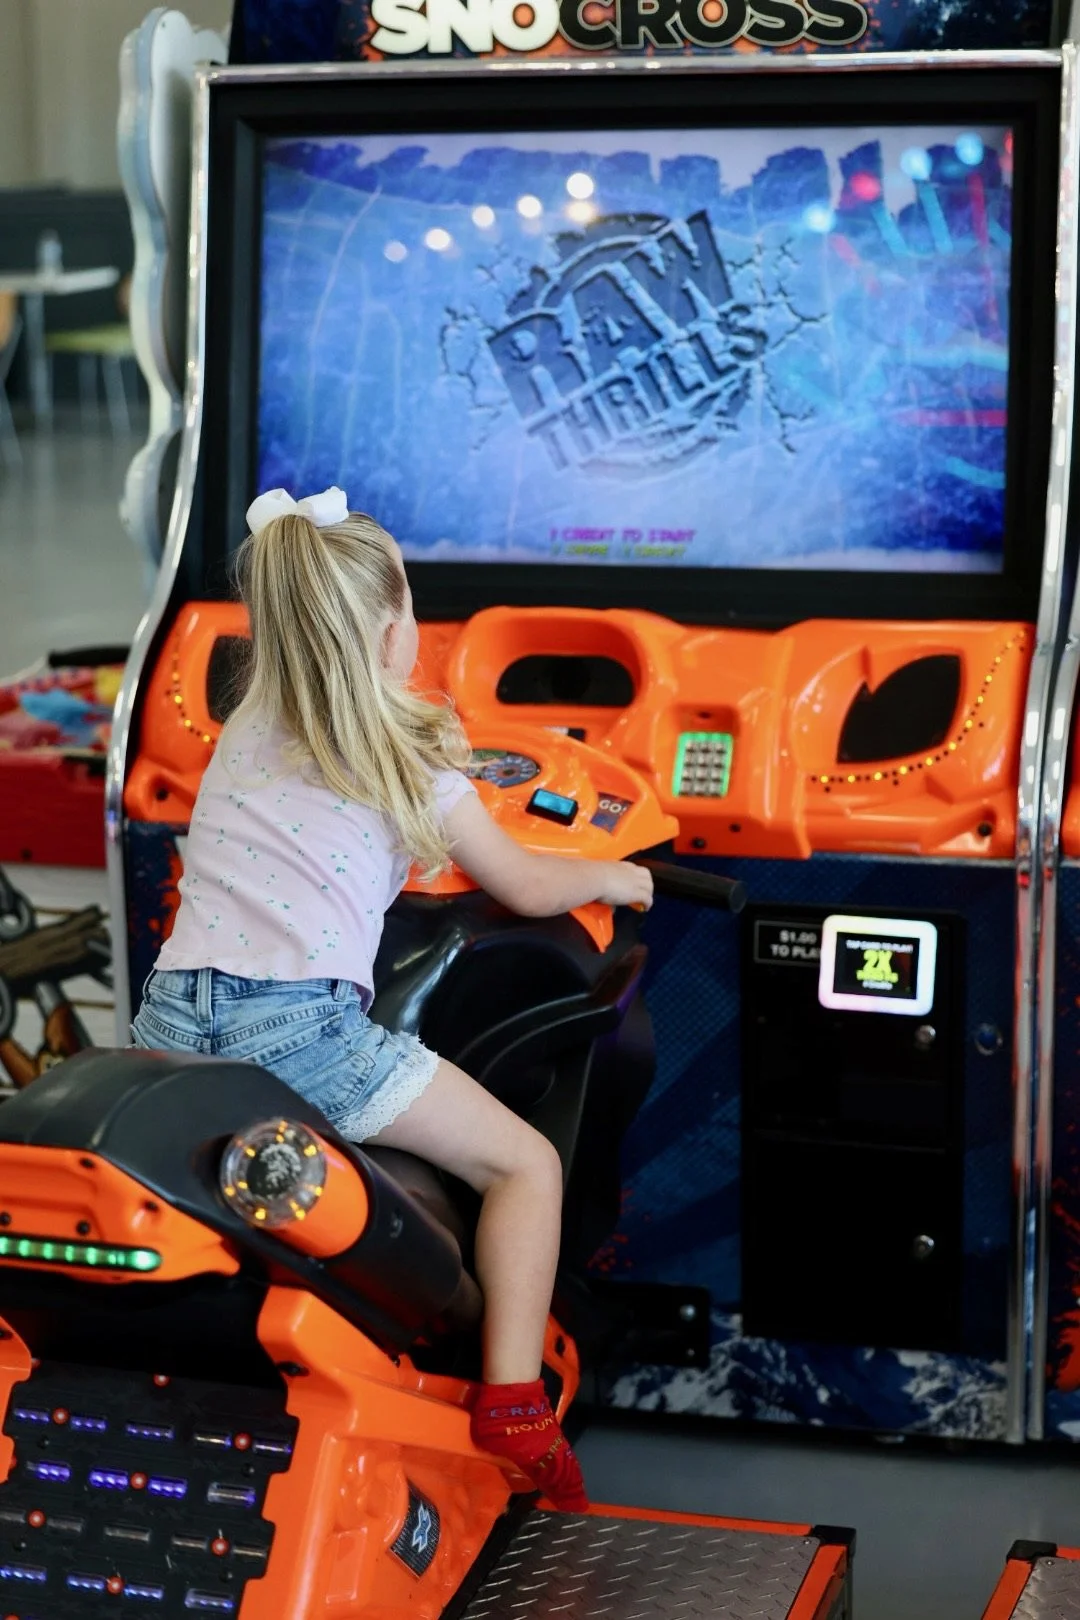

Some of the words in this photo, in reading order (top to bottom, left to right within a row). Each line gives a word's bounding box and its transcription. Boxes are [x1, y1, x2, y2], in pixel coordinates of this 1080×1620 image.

[487, 208, 734, 421] RAW
[527, 303, 768, 471] THRILLS
[599, 799, 627, 814] GO!
[770, 944, 790, 957] TO
[792, 945, 820, 959] PLA
[863, 949, 893, 972] 2X
